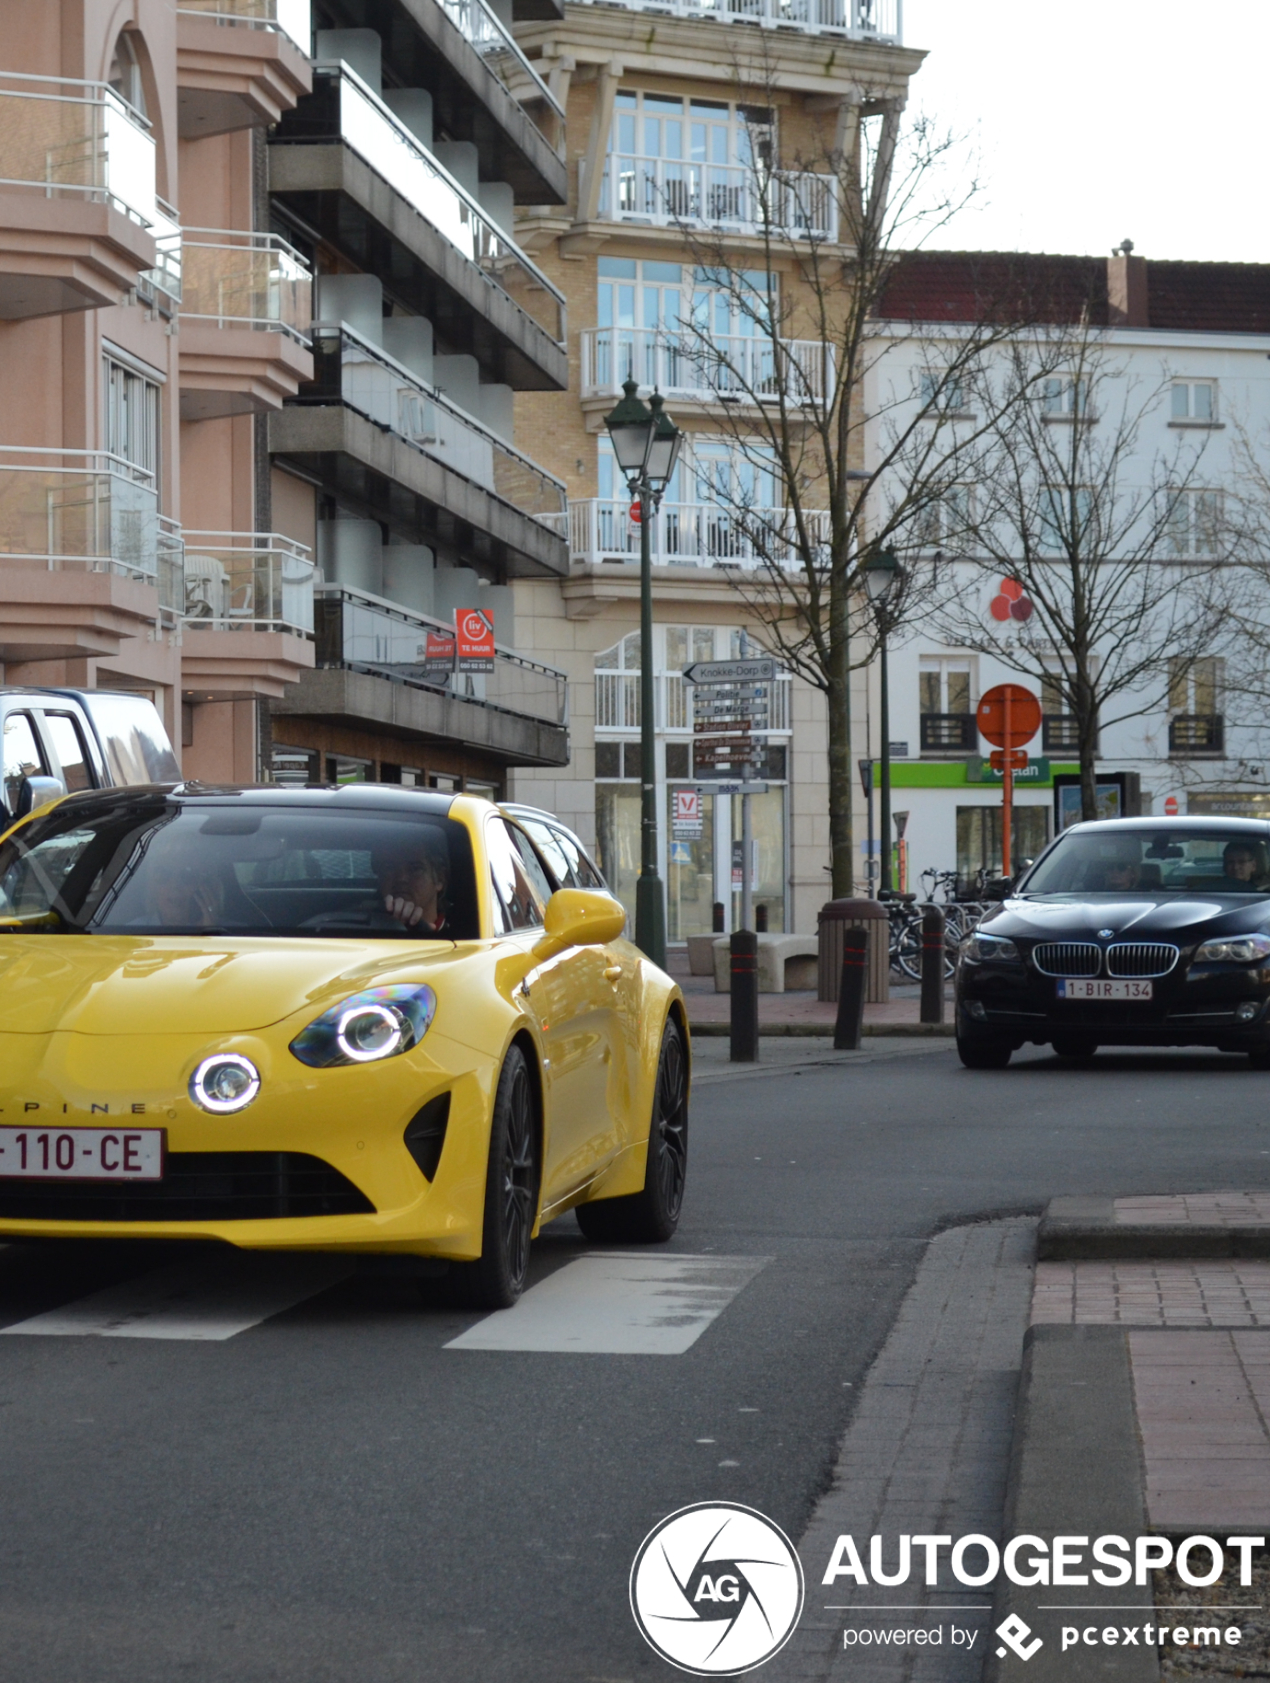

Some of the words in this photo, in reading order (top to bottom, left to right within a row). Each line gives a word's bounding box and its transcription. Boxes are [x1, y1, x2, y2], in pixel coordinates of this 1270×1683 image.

[469, 620, 482, 630] liv
[700, 665, 759, 678] Knokke-Dorp
[716, 691, 740, 699] Politie
[714, 706, 722, 714] De
[726, 705, 750, 715] Marge
[993, 765, 1039, 776] Celan
[1069, 982, 1150, 997] 1-BIR-134
